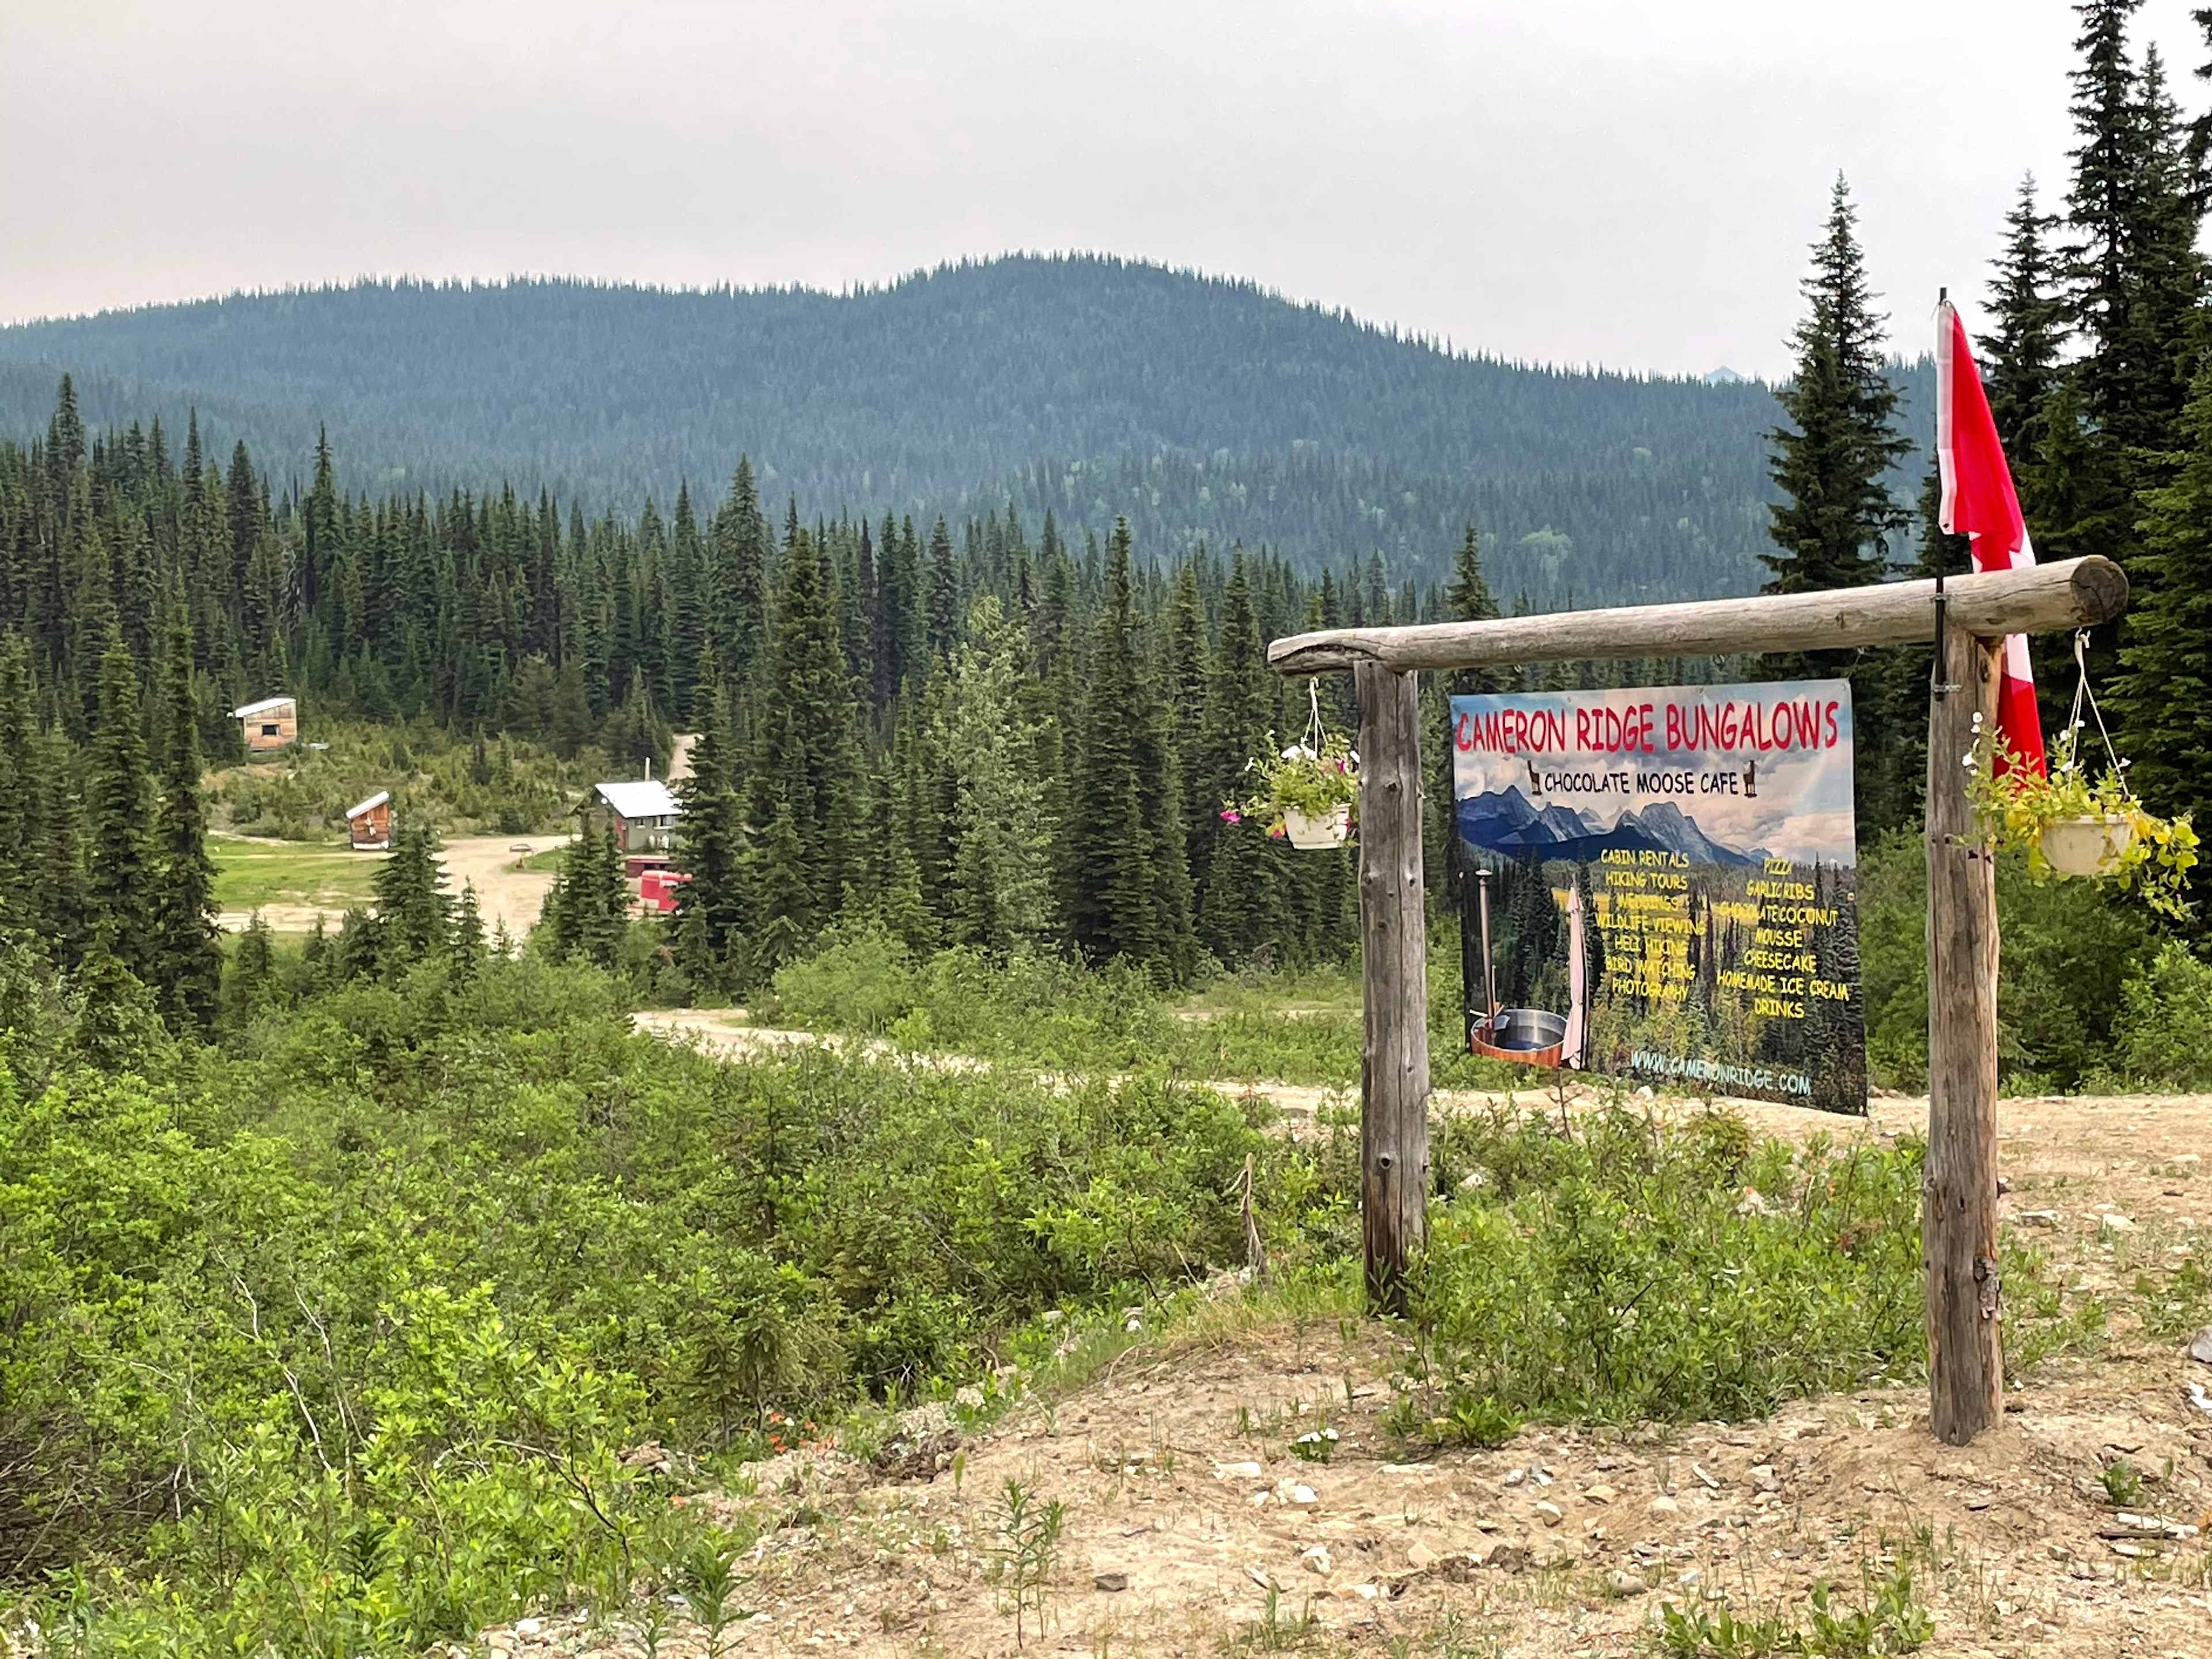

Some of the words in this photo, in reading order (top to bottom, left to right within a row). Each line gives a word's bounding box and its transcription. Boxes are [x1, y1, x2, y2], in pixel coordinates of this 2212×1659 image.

[1456, 708, 1566, 753] CAMERON
[1577, 703, 1654, 753] RIDGE
[1666, 700, 1839, 751] BUNGALOWS
[1545, 772, 1628, 795] CHOCOLATE
[1637, 772, 1694, 794] MOOSE
[1701, 772, 1738, 794] CAFE
[1601, 849, 1635, 865] CABIN
[1639, 850, 1689, 868] RENTALS
[1764, 857, 1792, 875] PIZZA
[1605, 870, 1647, 888] HIKING
[1650, 873, 1688, 891] TOURS
[1747, 879, 1782, 897] GARLIC
[1783, 882, 1815, 900] RIBS
[1617, 892, 1678, 911] WEDDINGS
[1719, 900, 1778, 922] CHOCOLATE
[1779, 906, 1838, 926] COCONUT
[1595, 912, 1649, 931] WILDLIFE
[1653, 917, 1707, 935] VIEWING
[1615, 934, 1641, 952] HELI
[1645, 935, 1688, 956] HIKING
[1755, 927, 1802, 948] MOUSSE
[1605, 956, 1632, 973] BIRD
[1636, 959, 1695, 980] WATCHING
[1744, 948, 1817, 974] CHEESECAKE
[1612, 977, 1690, 1001] PHOTOGRAPHY
[1717, 968, 1775, 993] HOMEMADE
[1779, 976, 1804, 995] ICE
[1809, 979, 1849, 1001] CREAM
[1754, 998, 1804, 1018] DRINKS
[1631, 1051, 1810, 1096] WWW.CAMERONRIDGE.COM
